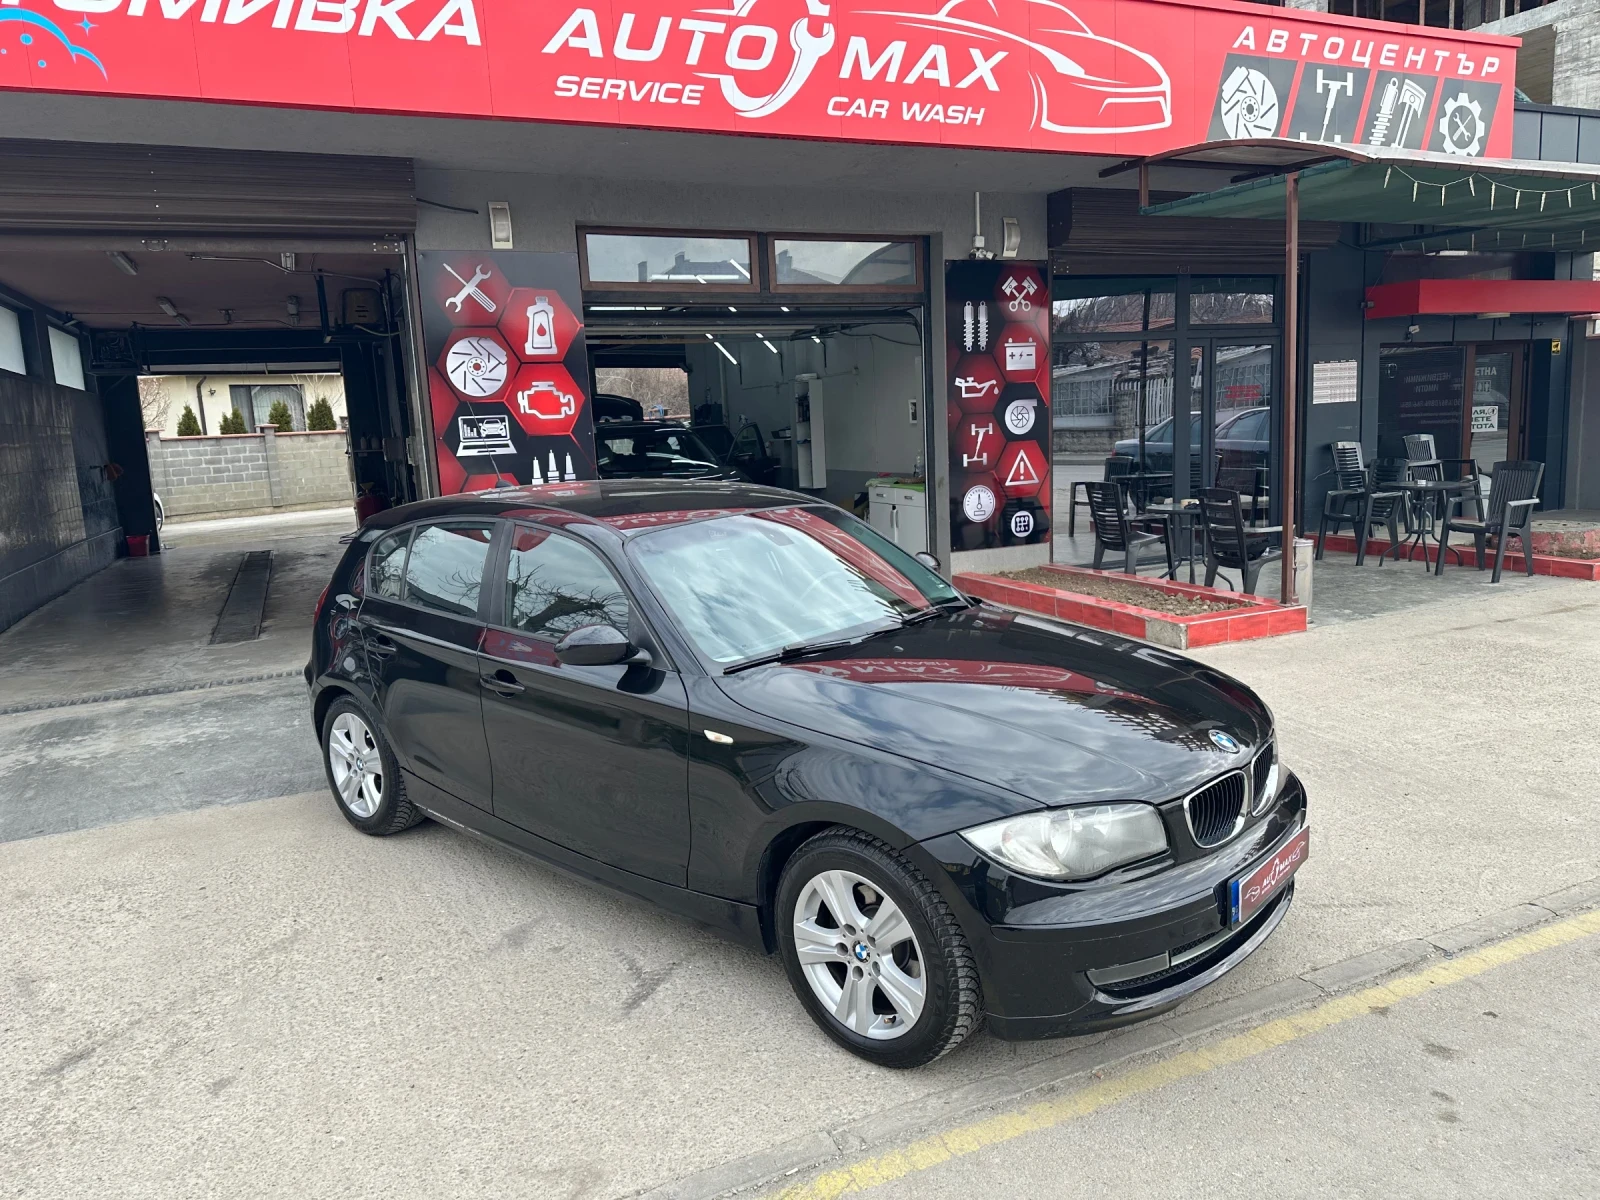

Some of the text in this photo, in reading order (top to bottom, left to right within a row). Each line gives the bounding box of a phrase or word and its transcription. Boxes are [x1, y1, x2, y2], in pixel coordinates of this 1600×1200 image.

[0, 0, 482, 46] ИВКА
[541, 8, 1009, 92] AUTO MAX
[1233, 26, 1500, 77] АВТОЦЕНТЪР
[554, 75, 705, 106] SERVICE
[827, 96, 986, 126] CAR WASH
